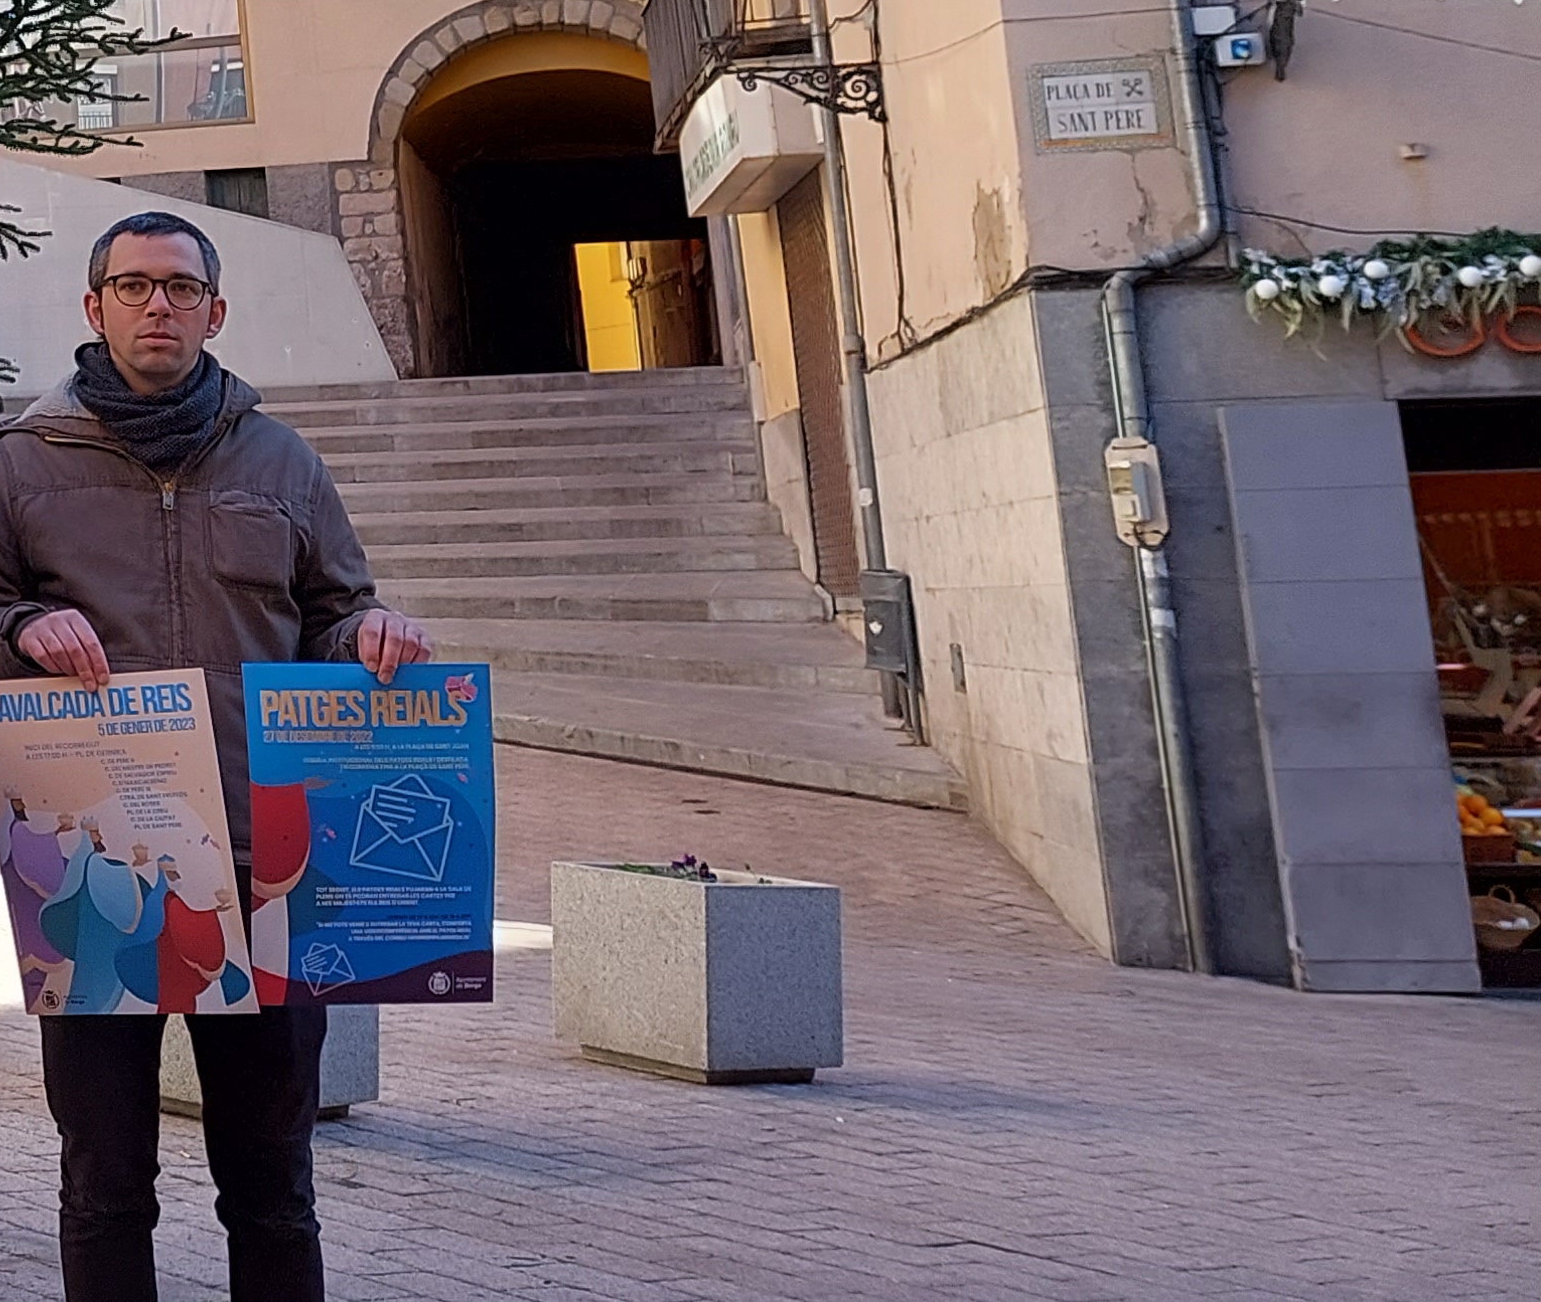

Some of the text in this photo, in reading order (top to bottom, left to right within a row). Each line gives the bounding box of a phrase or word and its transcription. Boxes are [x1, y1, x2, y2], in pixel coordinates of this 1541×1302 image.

[1047, 82, 1114, 102] PLAÇA DE
[1057, 108, 1146, 133] SANT PERE
[107, 686, 138, 717] DE
[140, 682, 193, 714] REIS
[259, 689, 468, 727] PATGES REIALS
[98, 717, 196, 736] 5 DE GENER DE 2023
[263, 730, 274, 743] 27
[350, 730, 373, 743] 2022
